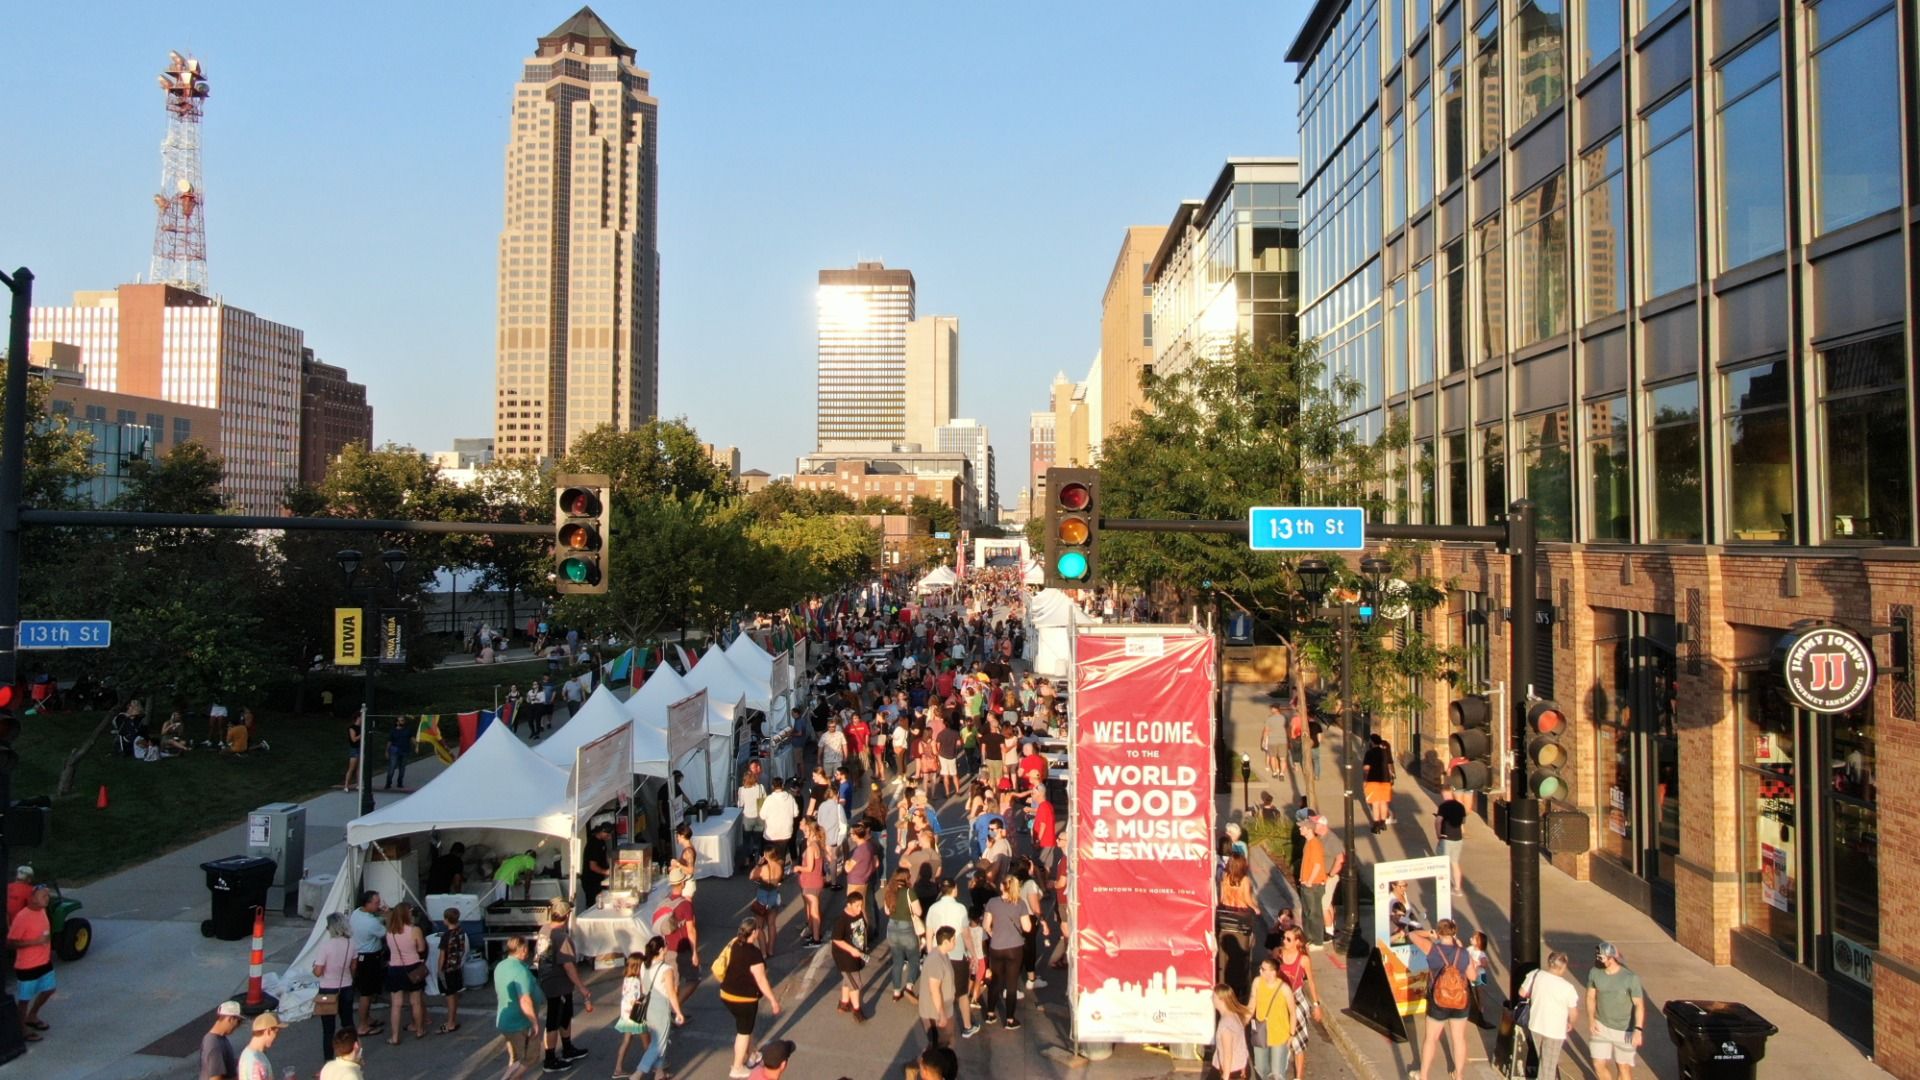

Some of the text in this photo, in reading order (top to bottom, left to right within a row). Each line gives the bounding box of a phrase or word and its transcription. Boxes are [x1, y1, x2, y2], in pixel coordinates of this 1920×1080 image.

[1269, 518, 1345, 539] 13th St
[29, 626, 100, 641] 13th St
[342, 615, 355, 658] IOWA
[386, 616, 396, 659] IOWA MBA
[1791, 635, 1864, 672] JIMMY JOHN'S
[1809, 652, 1846, 690] JJ
[1793, 676, 1864, 706] GOURMET SANDWICHES
[1092, 721, 1194, 744] WELCOME
[1126, 750, 1160, 758] TO THE
[1092, 765, 1197, 786] WORLD
[1092, 789, 1197, 816] FOOD
[1093, 818, 1197, 839] & MUSIC
[1092, 842, 1198, 860] FESTIVAL
